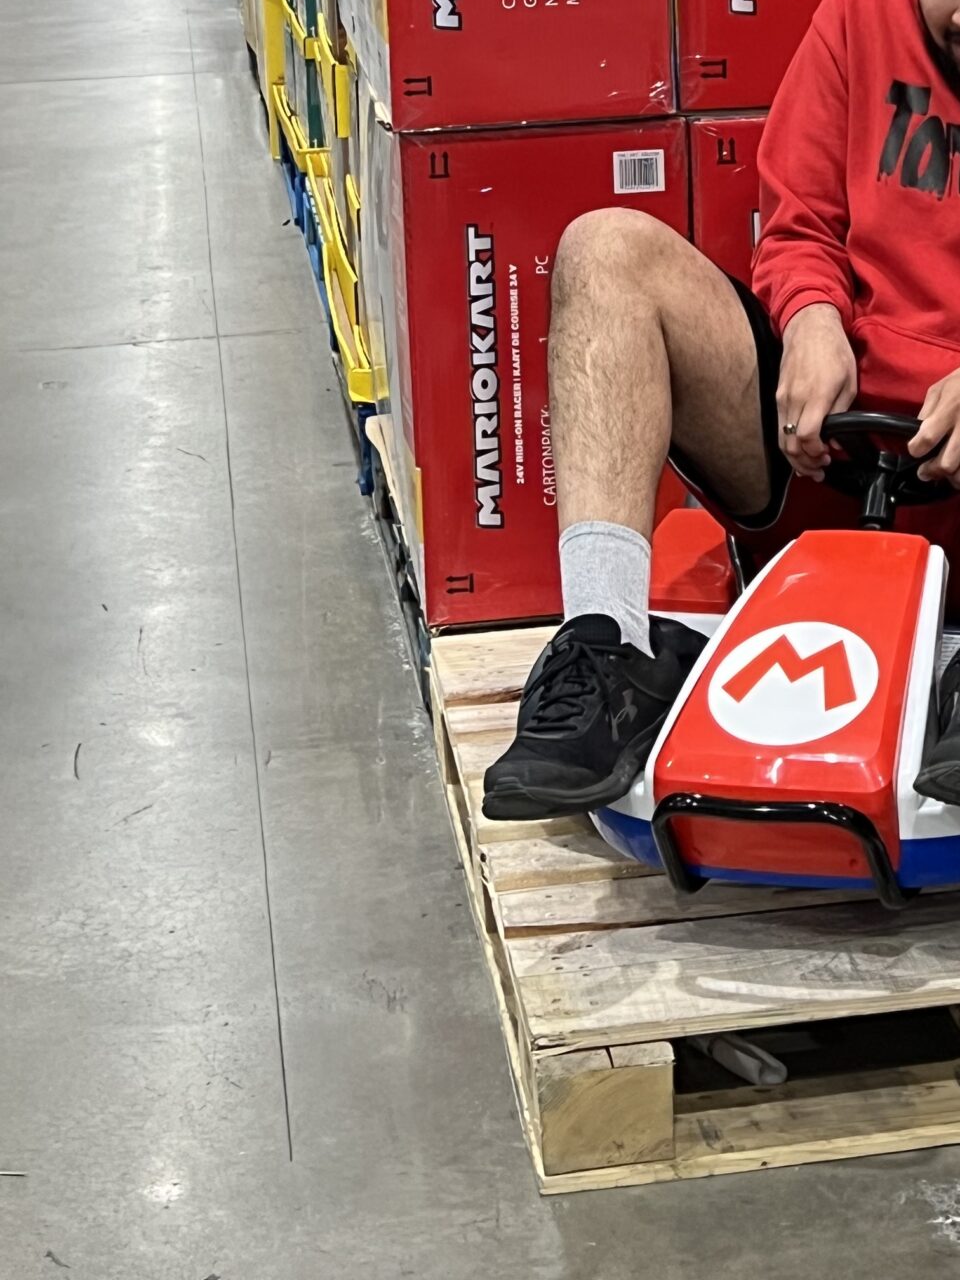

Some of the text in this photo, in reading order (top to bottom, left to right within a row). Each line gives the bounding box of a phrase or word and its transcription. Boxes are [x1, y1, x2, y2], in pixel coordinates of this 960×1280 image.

[535, 255, 548, 275] PC
[467, 223, 504, 529] MARIOKART
[722, 633, 858, 713] M
